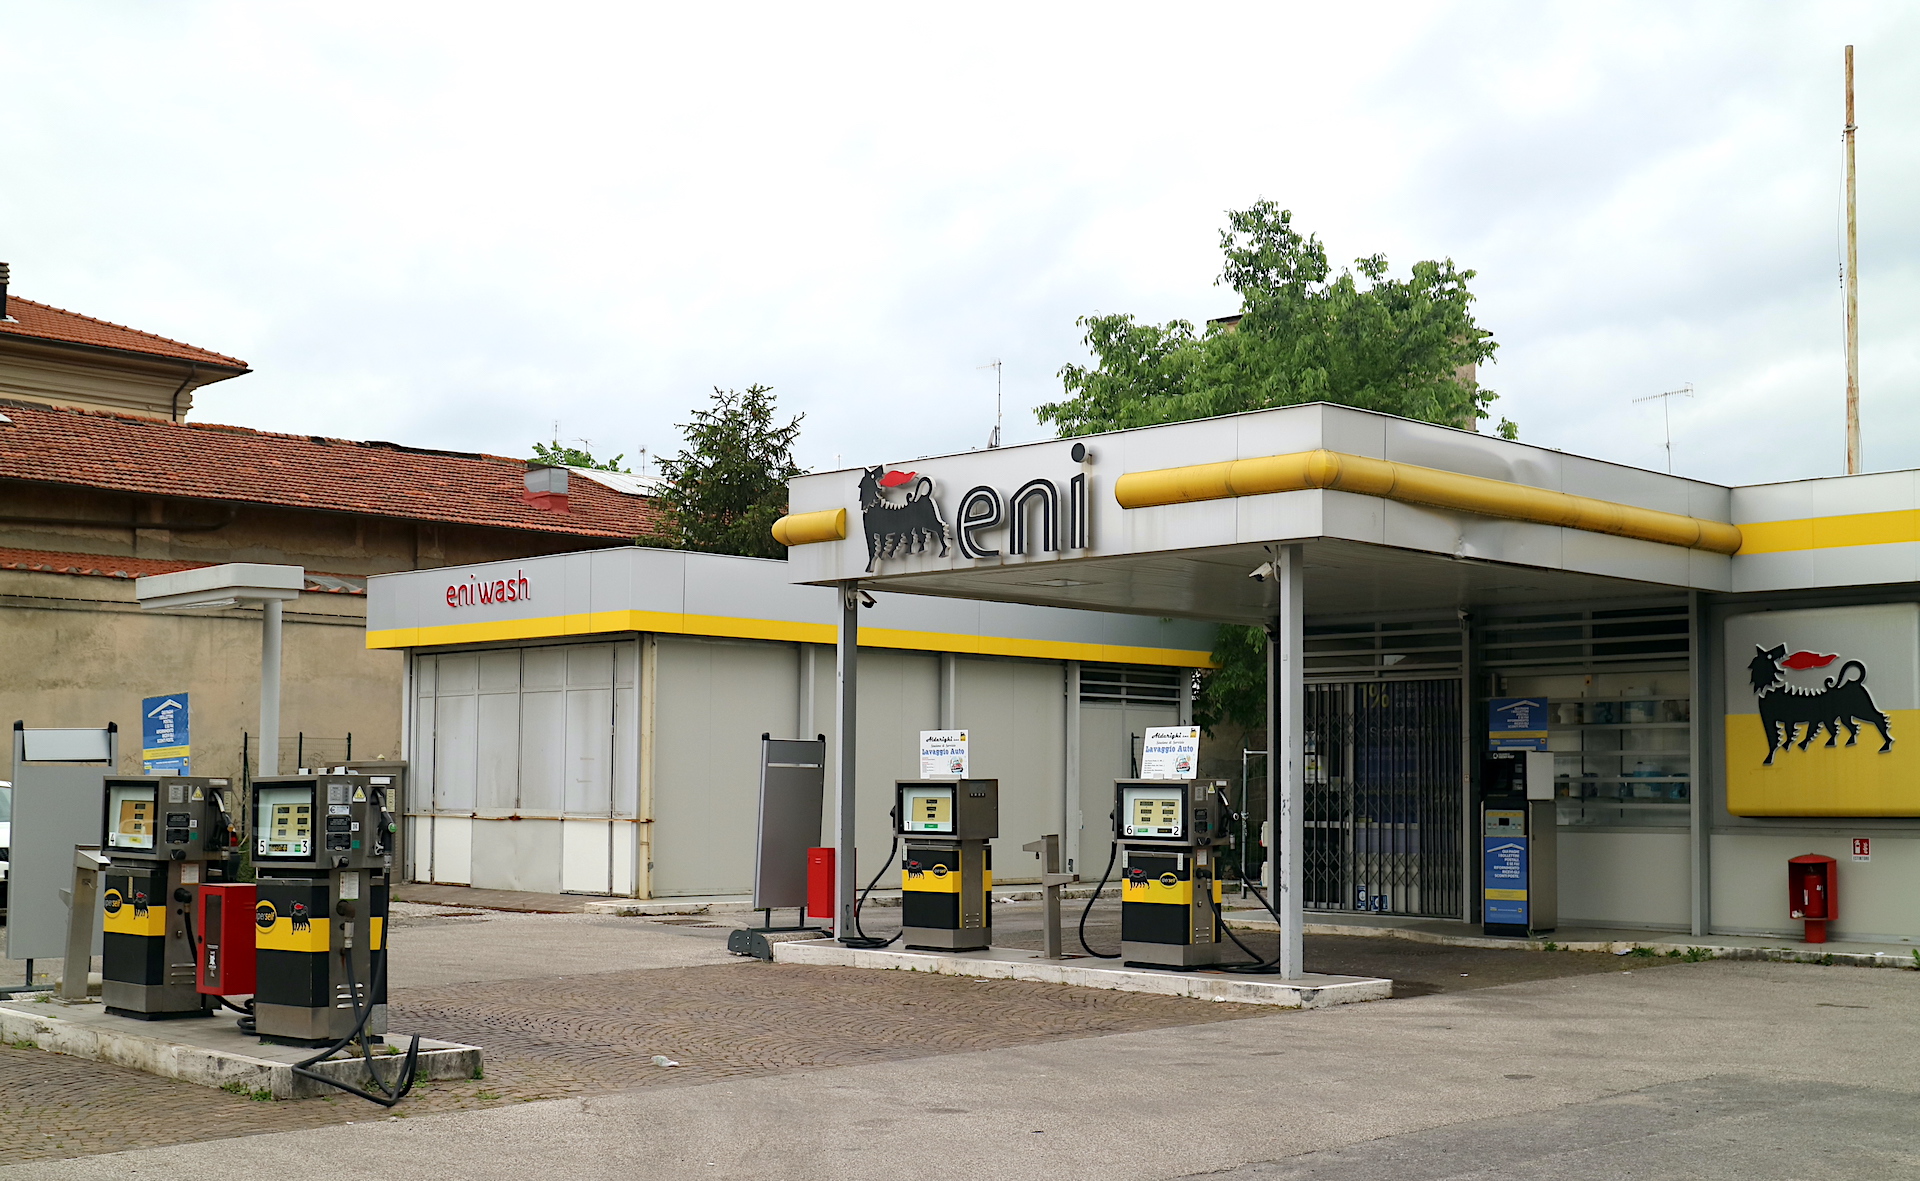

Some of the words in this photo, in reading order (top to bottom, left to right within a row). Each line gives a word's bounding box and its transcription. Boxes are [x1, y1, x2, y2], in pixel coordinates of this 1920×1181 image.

[957, 442, 1089, 560] eni
[446, 568, 531, 608] eniwash
[1126, 825, 1133, 835] 6
[1173, 826, 1179, 836] 2
[260, 840, 265, 853] 5
[302, 840, 308, 853] 3
